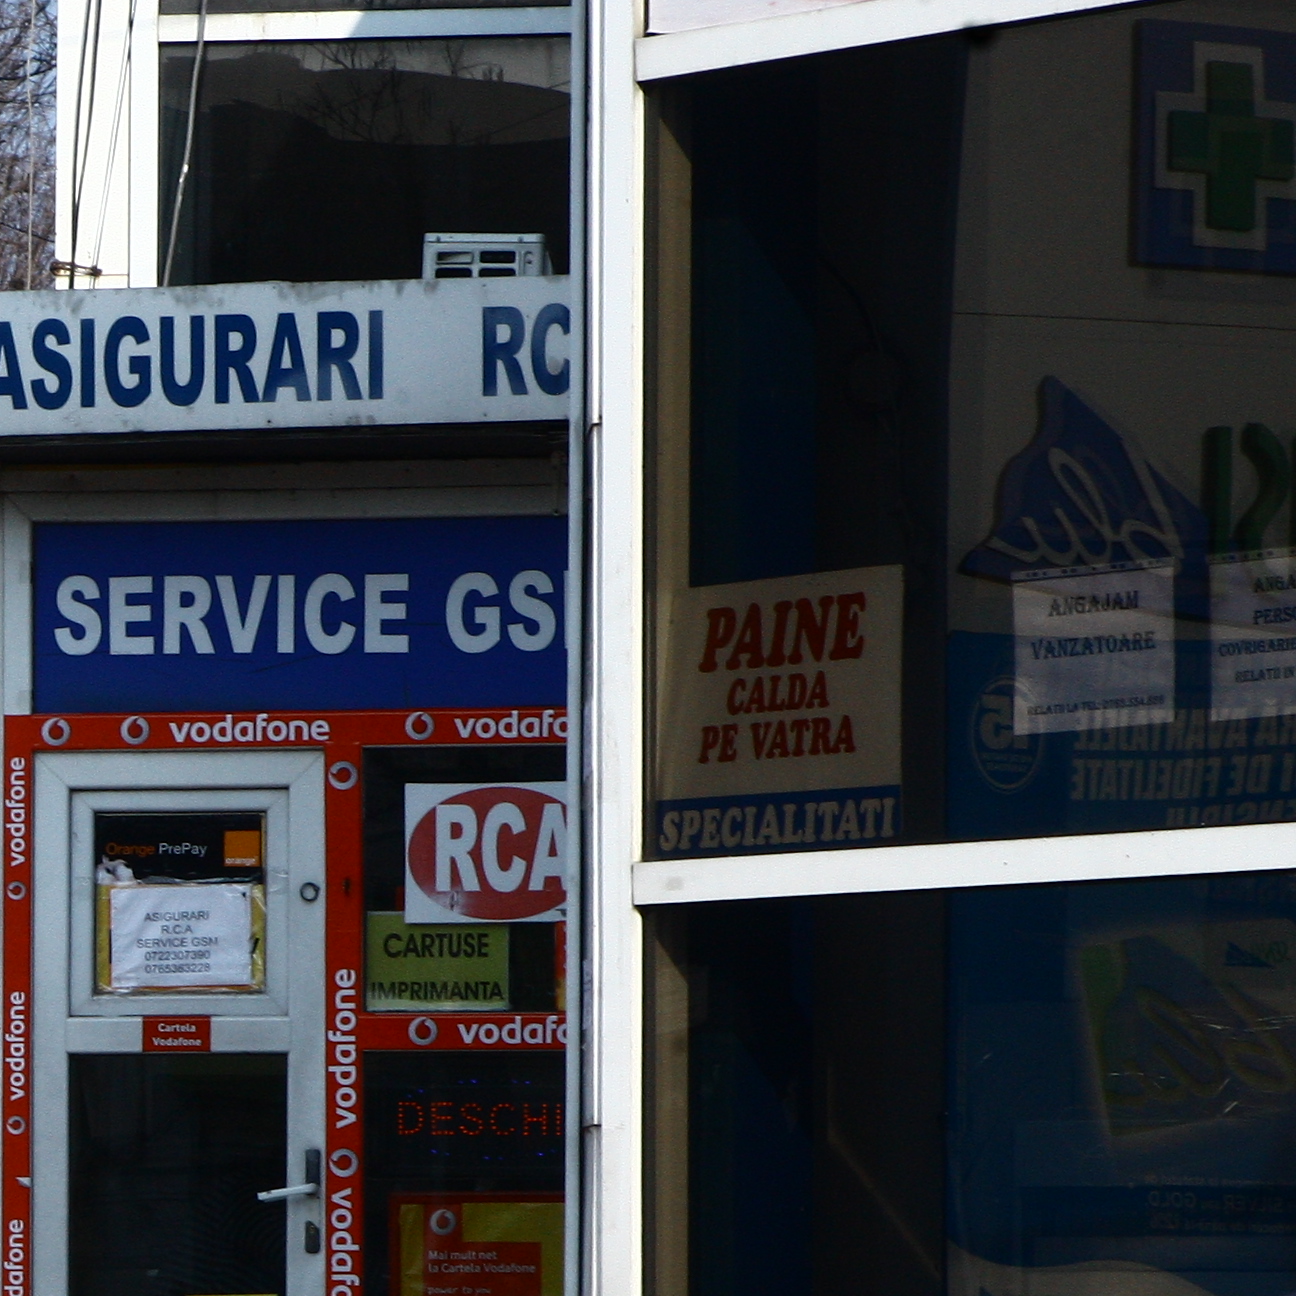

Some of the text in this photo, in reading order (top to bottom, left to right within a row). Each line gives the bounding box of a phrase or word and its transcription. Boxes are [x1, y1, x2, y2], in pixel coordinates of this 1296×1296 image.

[54, 570, 570, 656] SERVICE GS
[1049, 590, 1140, 617] ANGAJAM
[698, 591, 866, 673] PAINE
[727, 670, 830, 716] CALDA
[169, 713, 330, 743] vodafone
[699, 715, 856, 764] PE VATRA
[5, 756, 26, 867] vodafone
[659, 797, 897, 851] SPECIALITATI
[105, 842, 208, 858] Orange PrePay
[435, 801, 568, 893] RCA
[144, 910, 209, 922] ASIGURARI
[136, 936, 219, 949] SERVICE GSM
[383, 933, 489, 959] CARTUSE
[371, 980, 505, 1001] IMPRIMANTA
[157, 1023, 197, 1033] Cartela
[5, 990, 26, 1102] vodafone
[152, 1037, 203, 1047] Vodafone
[327, 968, 358, 1130] vodafone
[428, 1263, 537, 1273] la Cartela Vodafone
[479, 1250, 498, 1260] net
[462, 1286, 473, 1295] to
